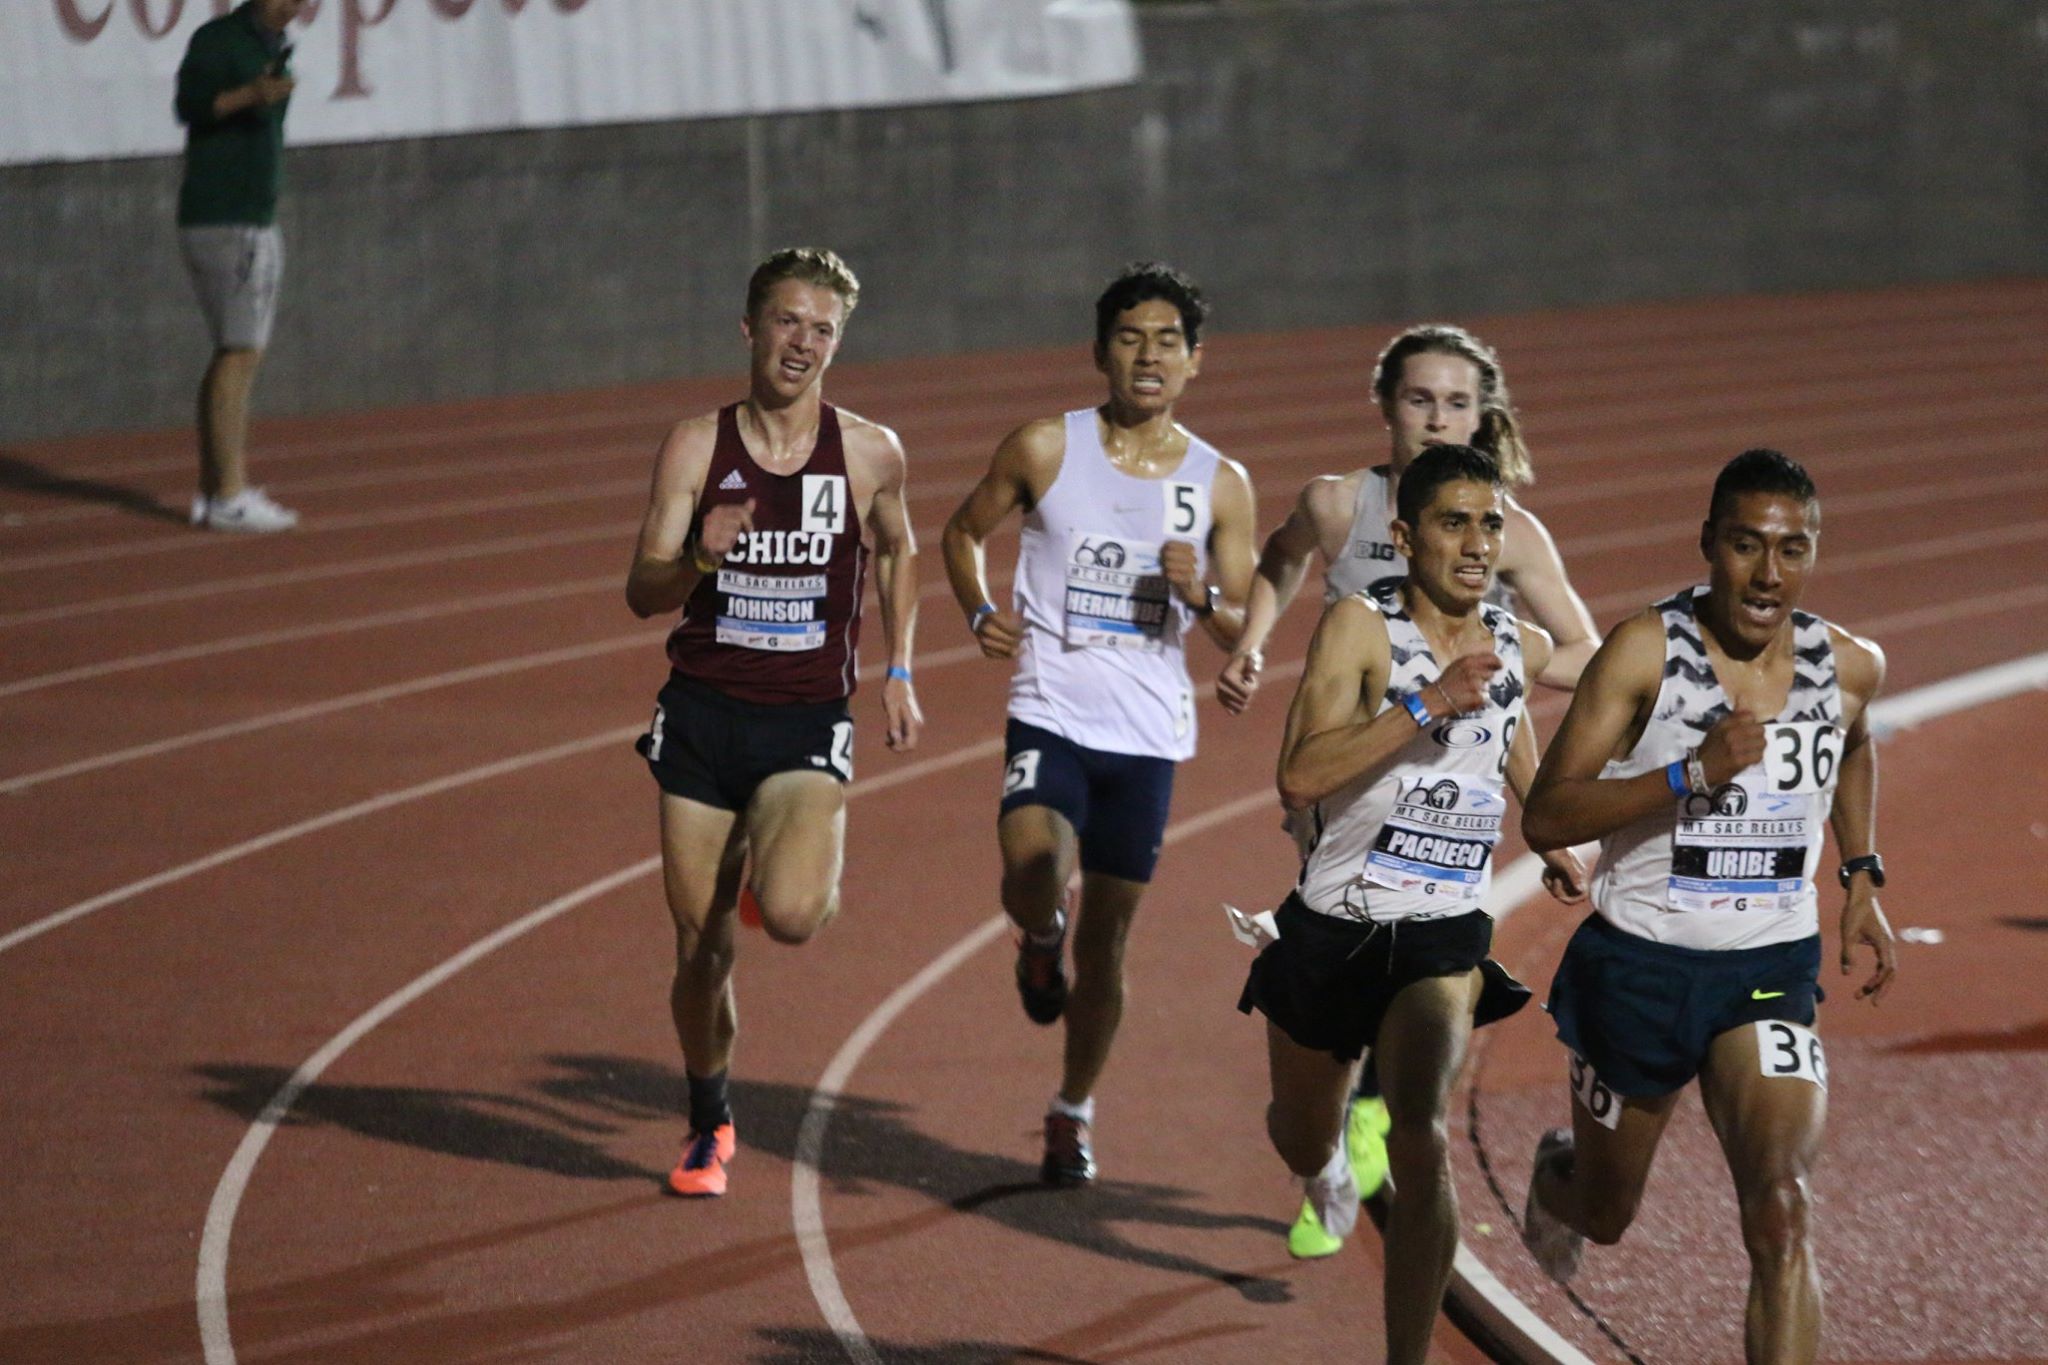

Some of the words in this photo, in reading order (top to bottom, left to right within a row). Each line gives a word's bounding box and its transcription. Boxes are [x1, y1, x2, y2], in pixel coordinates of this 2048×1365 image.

[810, 479, 838, 529] 4
[1173, 485, 1196, 533] 5
[725, 530, 833, 565] CHICO
[746, 577, 768, 588] SAC
[776, 577, 822, 588] RELAYS
[726, 596, 815, 622] JOHNSON
[1006, 752, 1028, 793] 5
[1775, 724, 1834, 792] 36
[1422, 812, 1449, 825] SAC
[1455, 817, 1497, 828] RELAYS
[1715, 822, 1743, 834] SAC
[1750, 821, 1803, 834] RELAYS
[1387, 831, 1484, 868] PACHECO
[1706, 850, 1777, 877] URIBE
